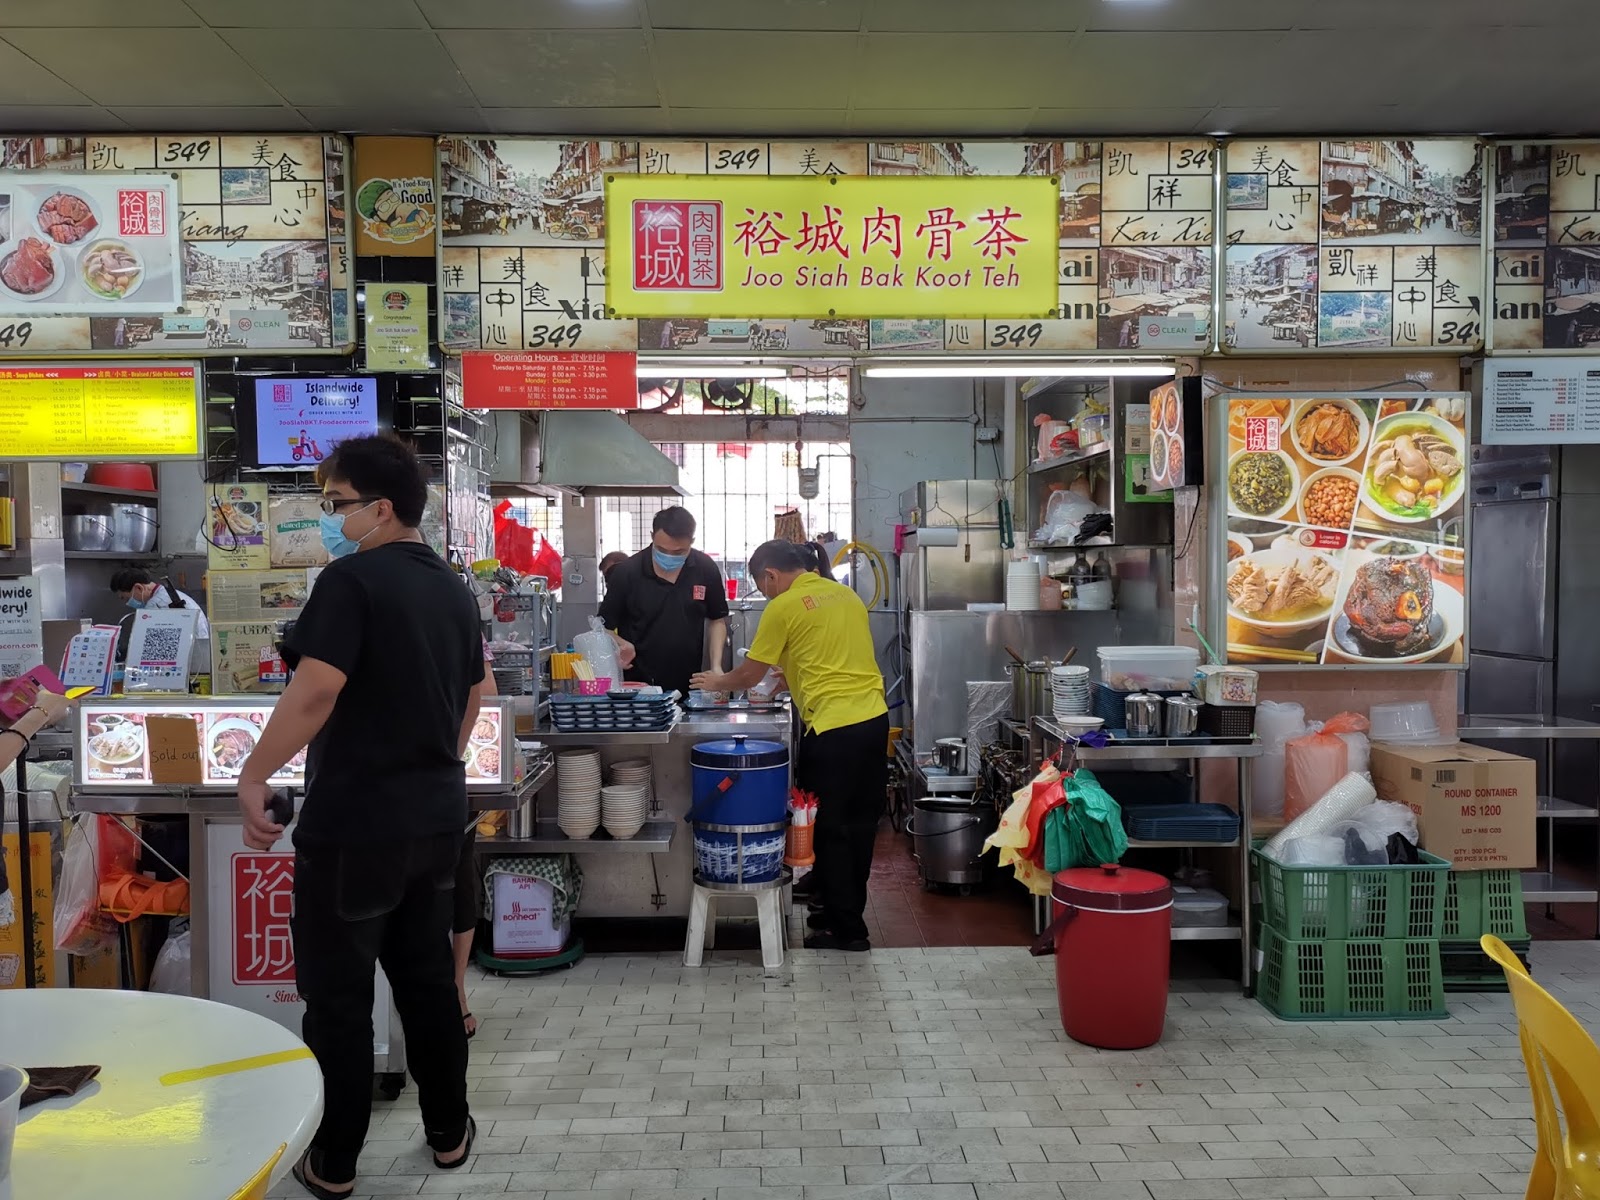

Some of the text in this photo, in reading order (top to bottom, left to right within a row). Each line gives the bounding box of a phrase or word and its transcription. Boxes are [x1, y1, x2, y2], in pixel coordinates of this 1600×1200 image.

[164, 141, 212, 162] 349
[714, 148, 761, 170] 349
[1107, 148, 1139, 177] 凯
[1555, 152, 1586, 178] 凯
[401, 188, 433, 205] Good
[1151, 178, 1182, 209] 祥
[120, 190, 146, 235] 裕城
[148, 192, 162, 233] 肉骨茶
[733, 203, 1030, 262] 裕城肉骨茶
[1111, 215, 1245, 250] Kai Xiag
[638, 203, 685, 287] 裕城
[691, 209, 715, 282] 肉骨茶
[740, 263, 1020, 288] Joo Siah Bak Koot Teh
[1059, 254, 1093, 278] ai
[253, 319, 281, 329] CLEAN
[529, 323, 583, 349] 349
[990, 322, 1043, 348] 349
[1161, 326, 1187, 335] CLEAN
[494, 353, 559, 363] Operating Hours
[305, 381, 364, 394] Islandwide
[310, 395, 360, 409] Delivery!
[1247, 417, 1267, 452] 裕城
[151, 747, 178, 764] Sold
[1445, 788, 1518, 798] ROUND CONTAINER
[1461, 805, 1502, 817] MS 1200
[273, 989, 302, 1004] Since
